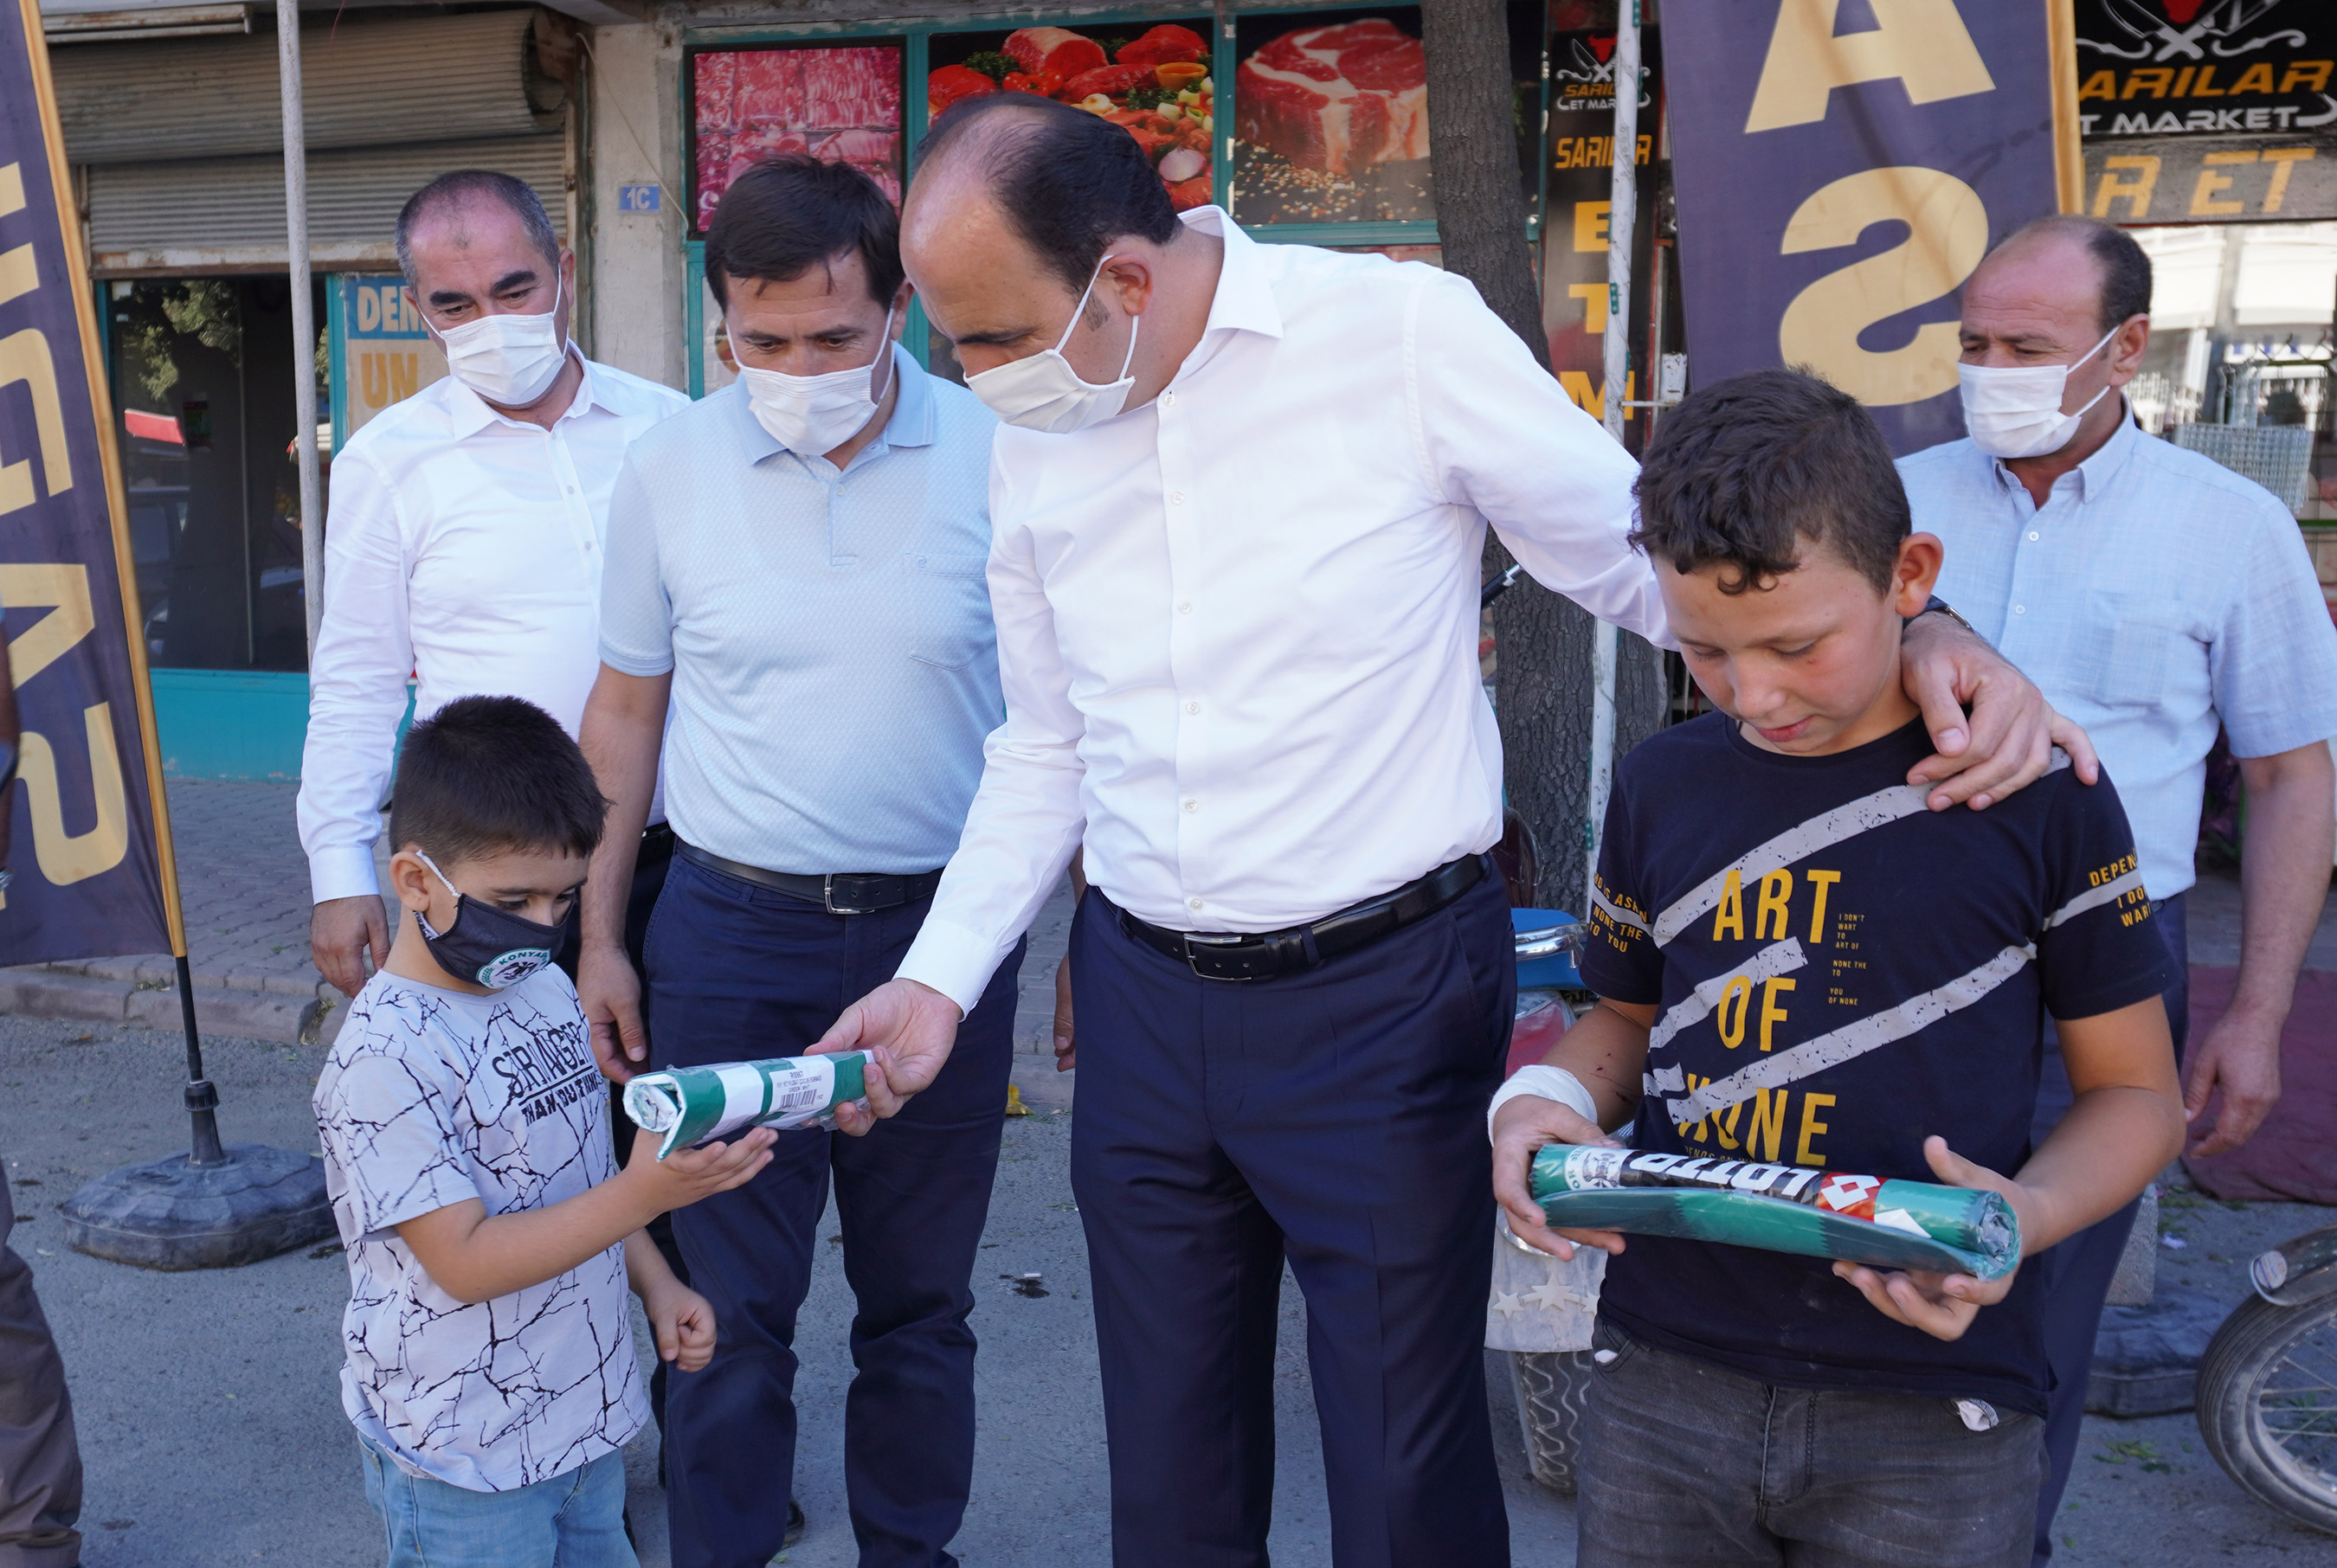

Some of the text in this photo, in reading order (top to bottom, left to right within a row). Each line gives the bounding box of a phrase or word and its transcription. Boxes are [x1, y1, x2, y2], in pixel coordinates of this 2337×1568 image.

[1565, 84, 1615, 97] SARIL
[2079, 61, 2334, 101] ARILAR
[1570, 99, 1616, 110] ET MAR
[2111, 106, 2301, 134] MARKET
[1555, 134, 1652, 168] SARILR
[627, 187, 649, 209] 1C
[2190, 148, 2316, 215] ET
[361, 353, 417, 408] UN
[2089, 848, 2138, 887] DEPEN
[1593, 905, 1643, 941] NONE THE
[1713, 869, 1841, 943] ART
[1589, 920, 1628, 953] TO YOU
[1833, 960, 1851, 968] NONE
[1830, 987, 1844, 996] YOU
[1718, 975, 1796, 1051] OF
[1629, 1153, 1819, 1197] LOTTO
